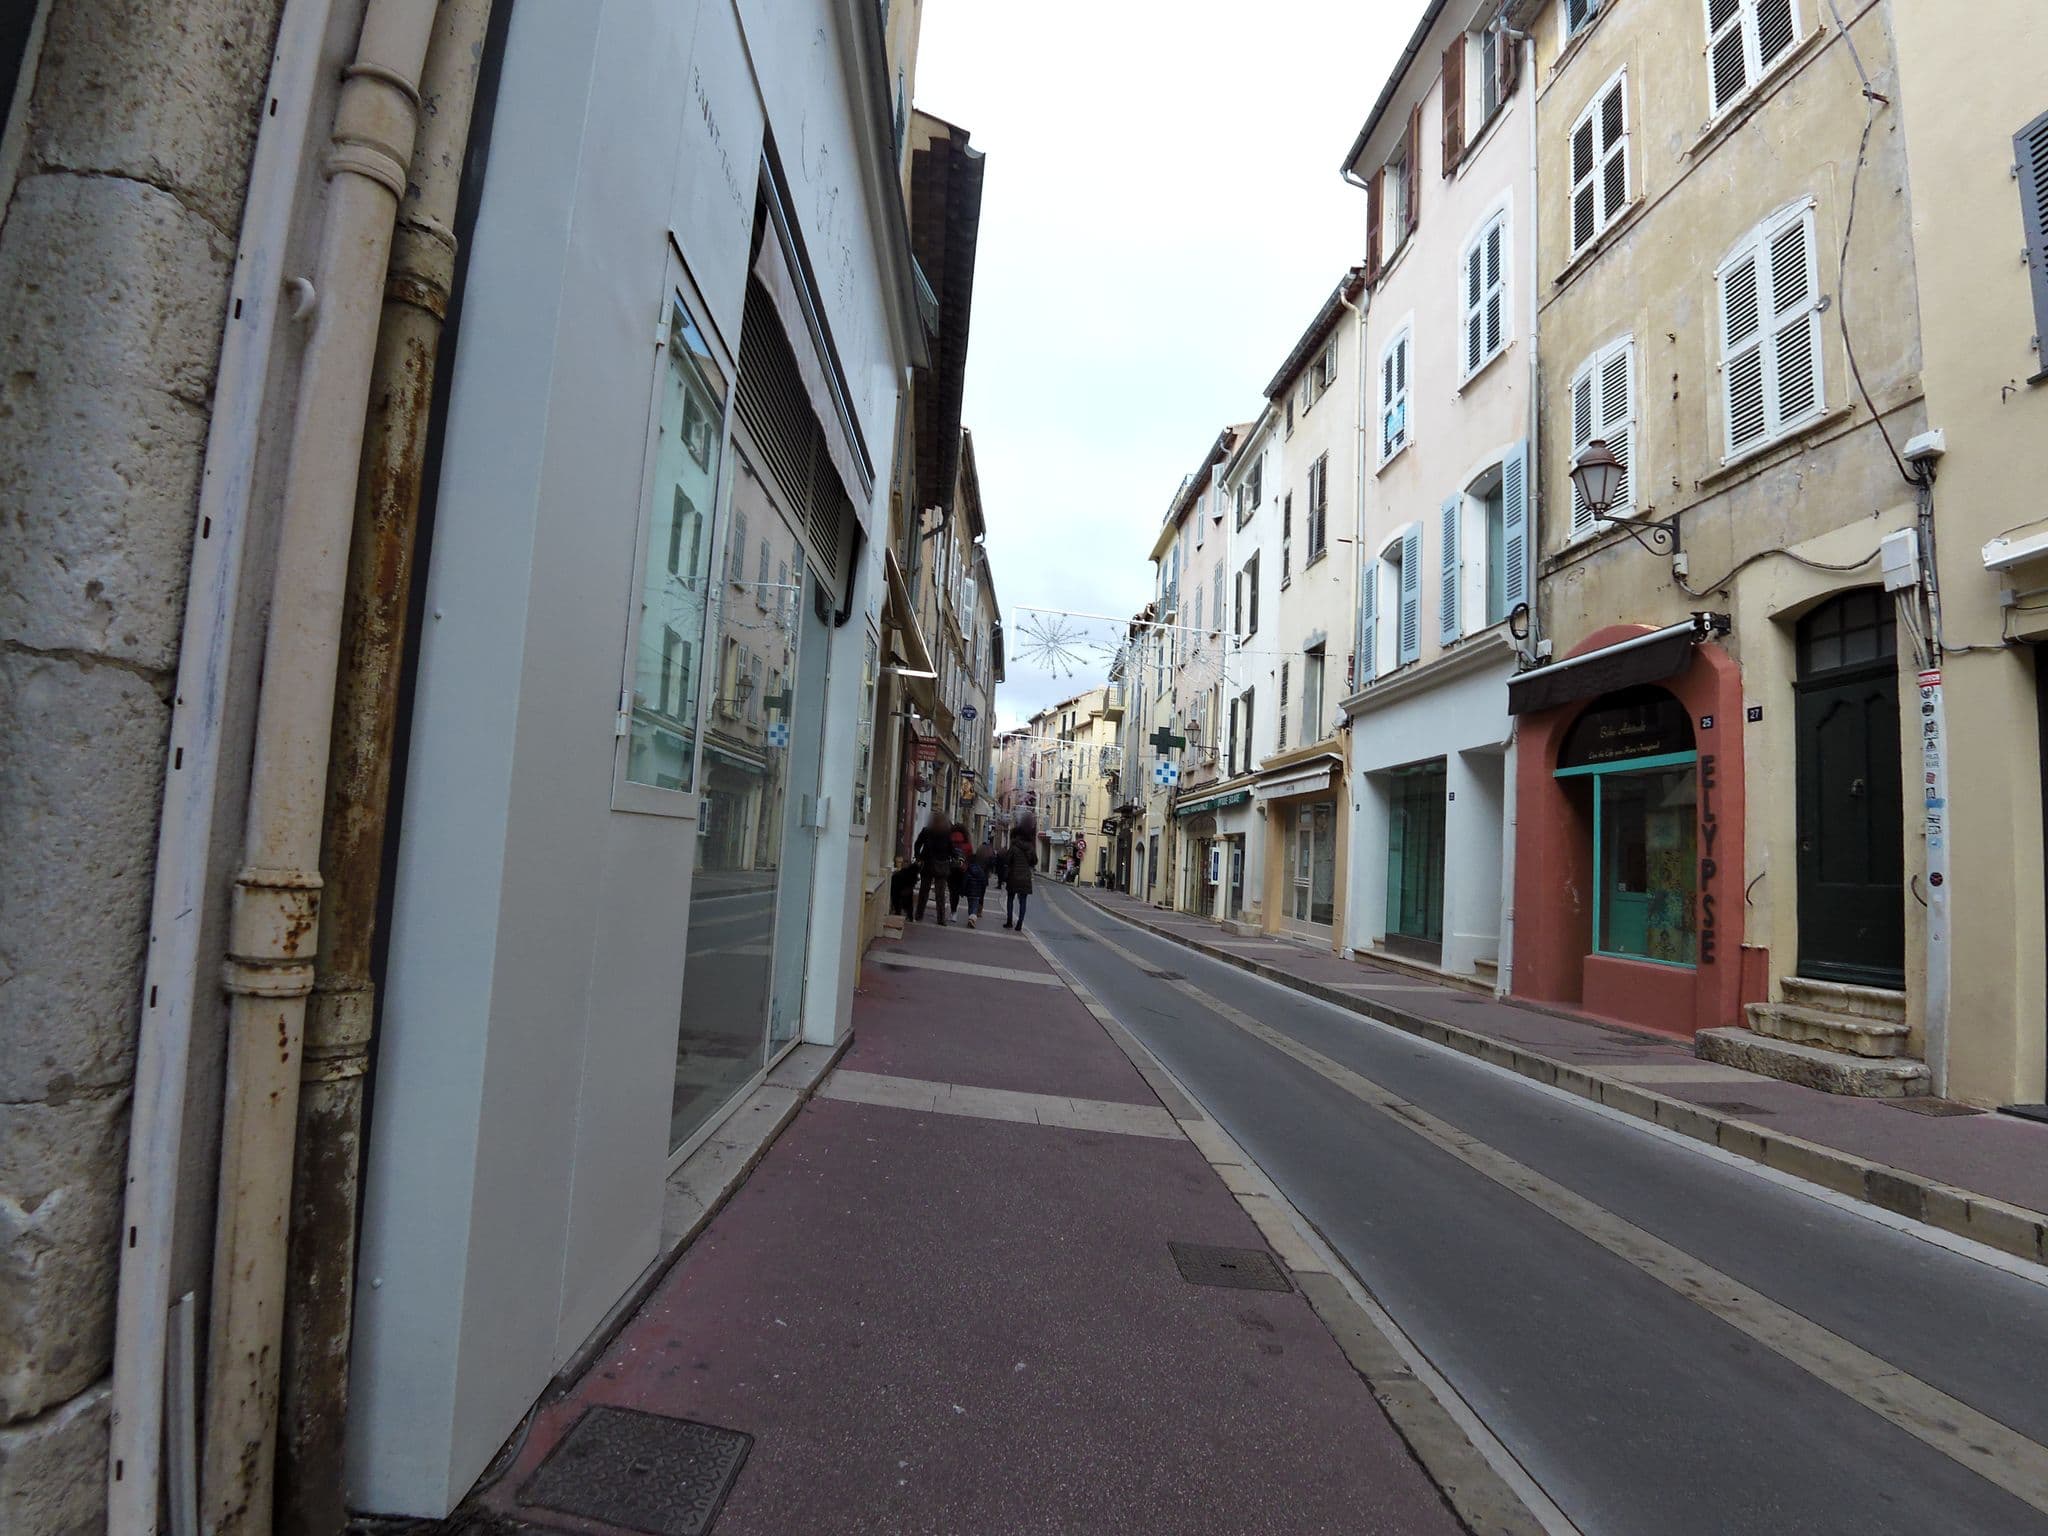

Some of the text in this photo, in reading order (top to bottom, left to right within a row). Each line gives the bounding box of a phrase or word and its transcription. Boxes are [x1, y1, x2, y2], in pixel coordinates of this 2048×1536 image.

[1749, 708, 1761, 719] 27
[1702, 717, 1712, 728] 25
[1701, 755, 1717, 965] ELYPSE
